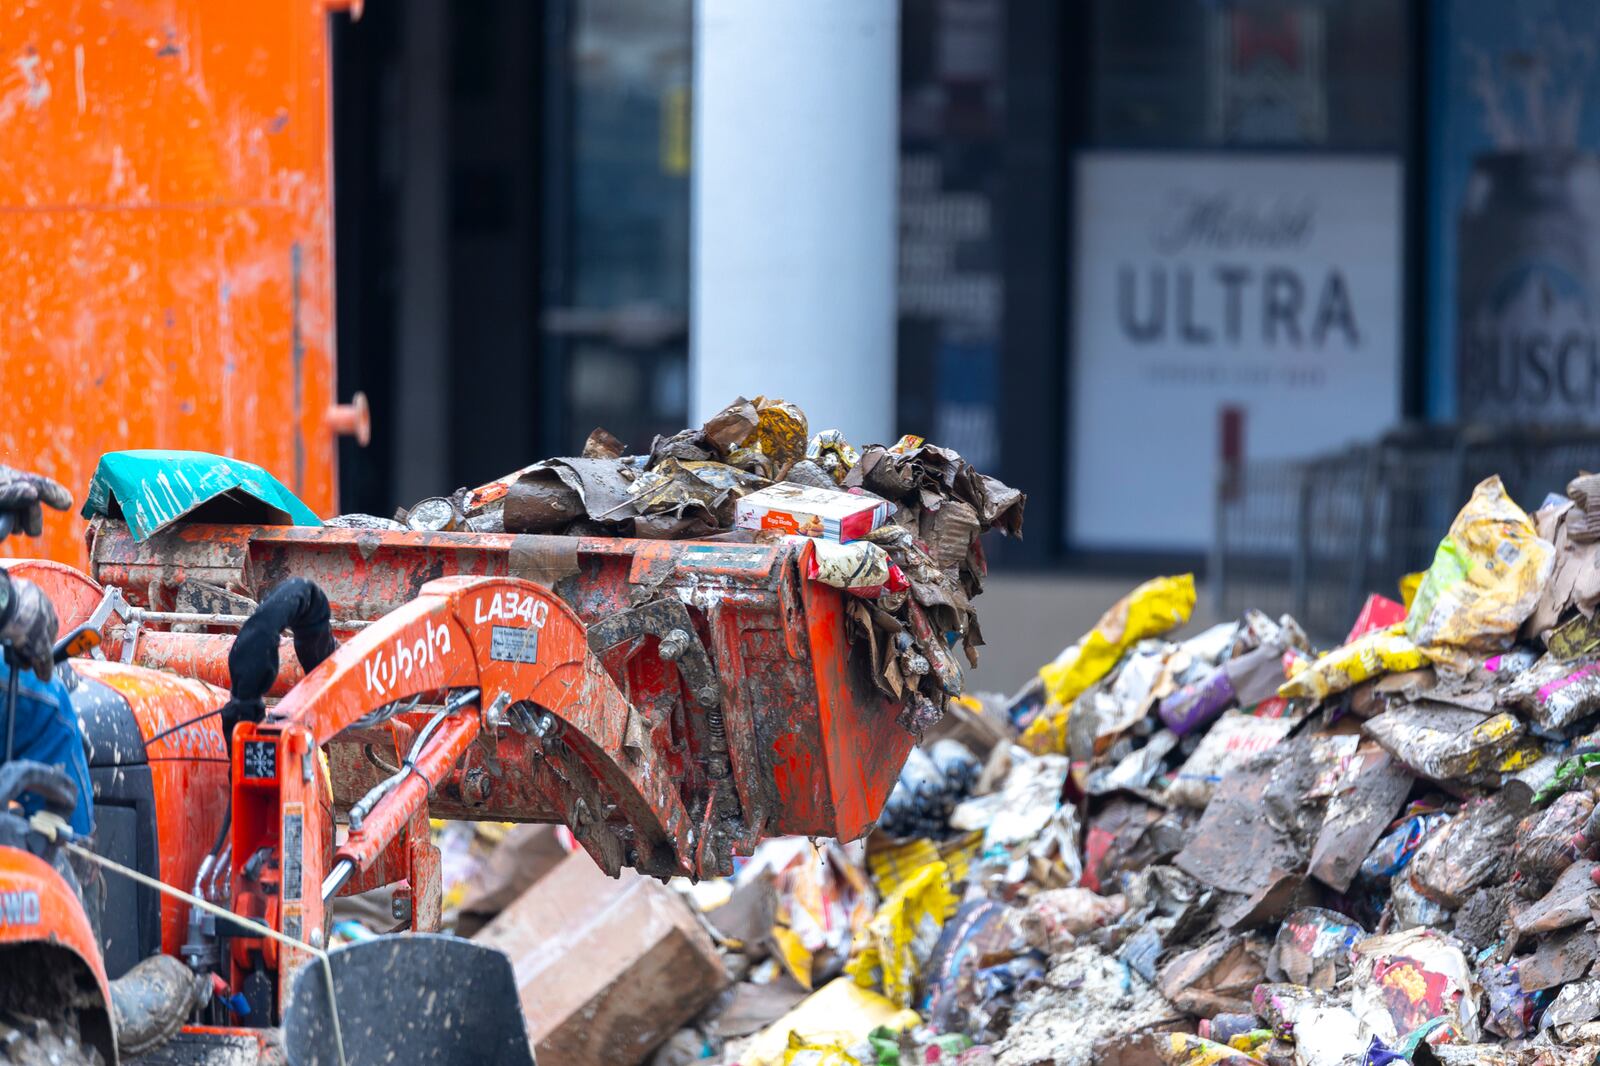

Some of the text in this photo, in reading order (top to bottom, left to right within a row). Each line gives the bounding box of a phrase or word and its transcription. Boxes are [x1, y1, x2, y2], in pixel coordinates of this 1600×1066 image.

[1117, 264, 1362, 347] ULTRA
[474, 592, 548, 628] LA340
[365, 620, 451, 695] Kubota
[0, 891, 40, 924] WD
